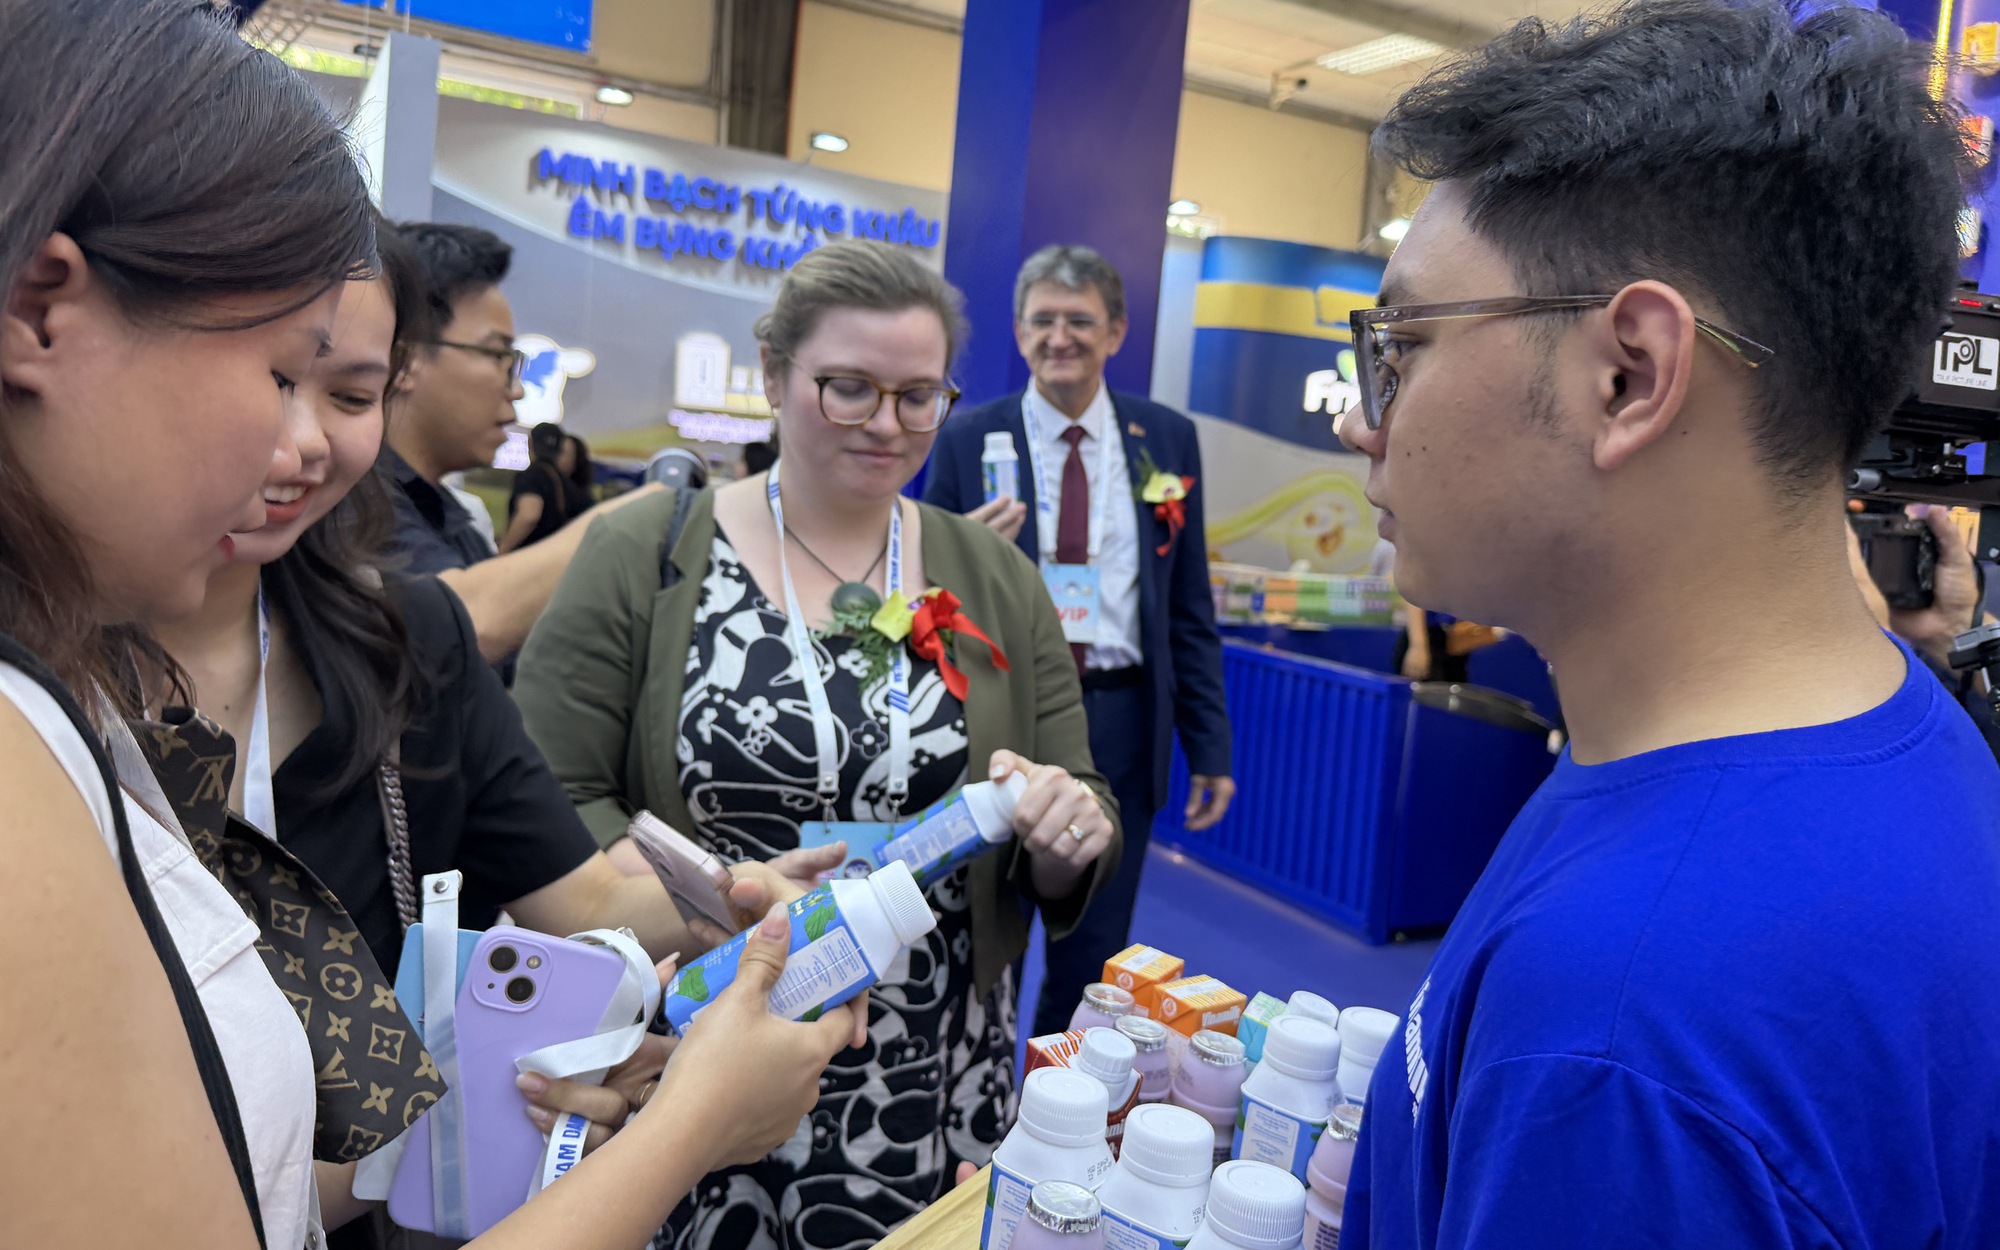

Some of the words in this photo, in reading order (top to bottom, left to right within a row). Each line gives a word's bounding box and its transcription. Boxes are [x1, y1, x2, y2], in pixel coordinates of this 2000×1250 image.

[538, 148, 634, 195] MINH
[643, 167, 741, 213] BẠCH
[568, 194, 626, 243] ÊM
[635, 216, 737, 260] BỤNG
[1940, 335, 1992, 376] TPL
[1055, 606, 1089, 621] VIP
[554, 1143, 577, 1179] AM
